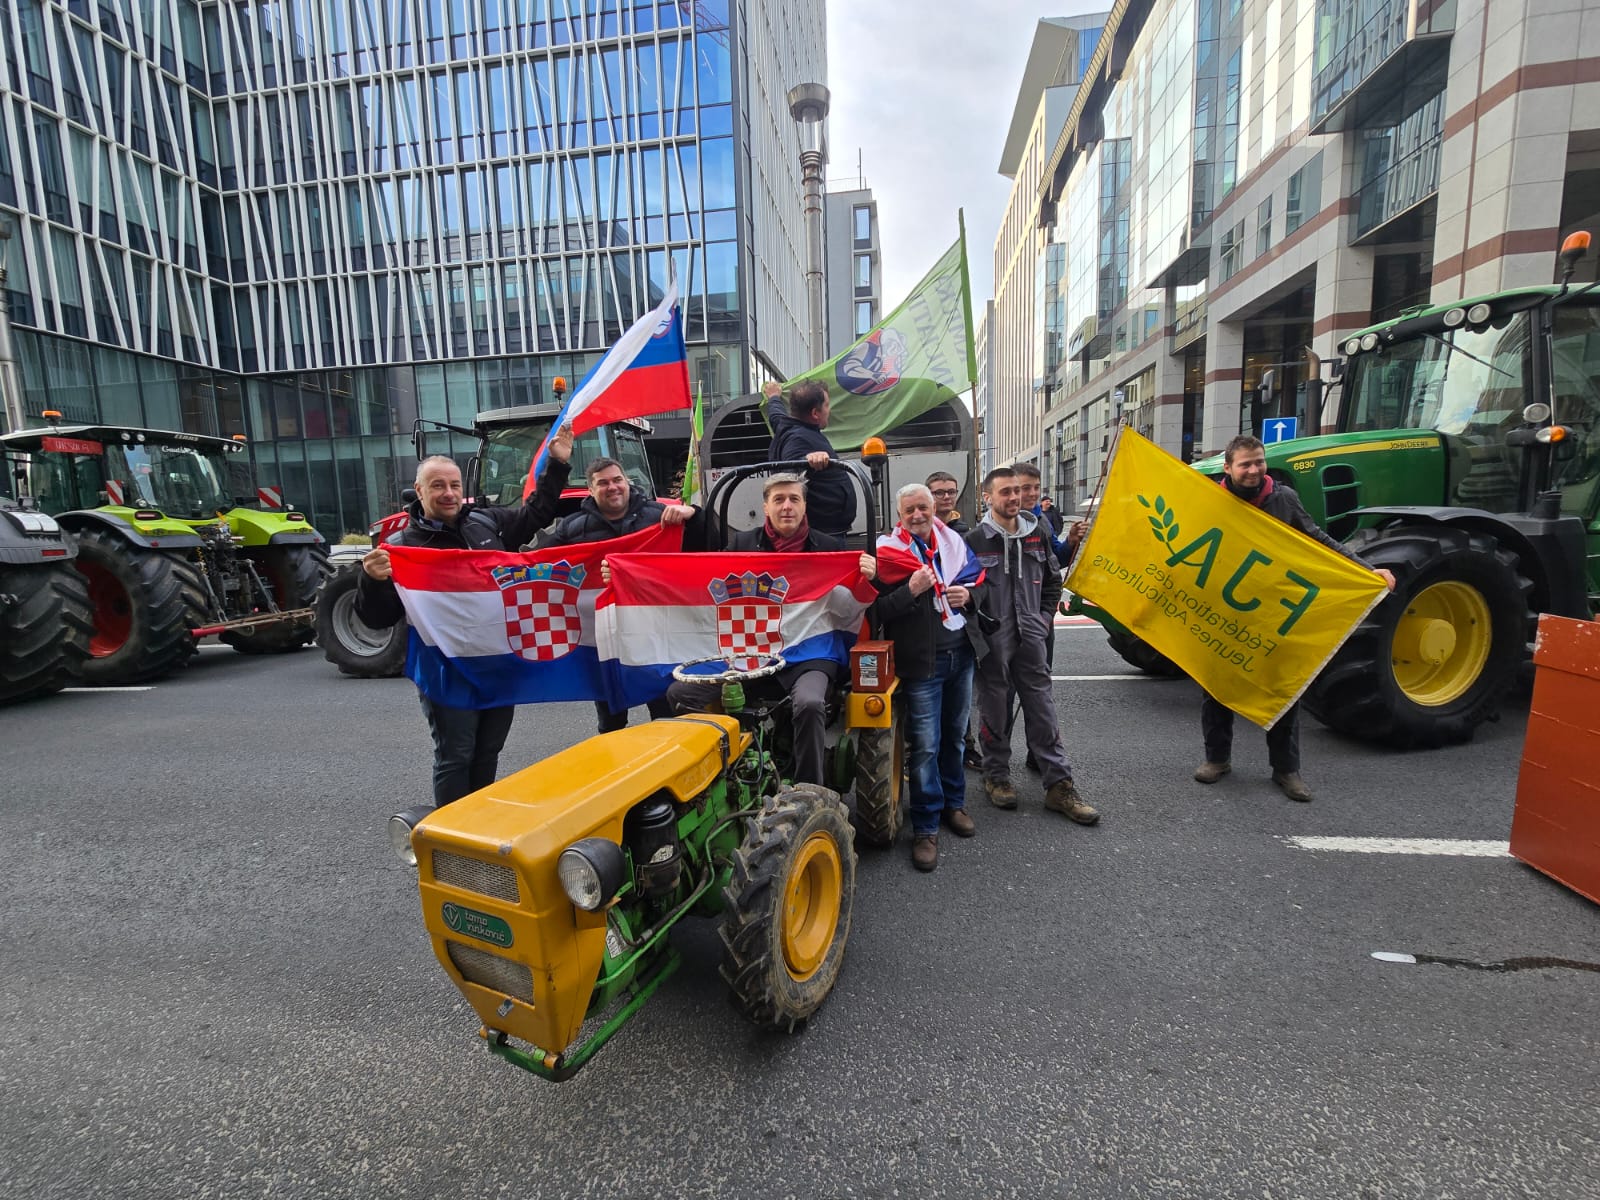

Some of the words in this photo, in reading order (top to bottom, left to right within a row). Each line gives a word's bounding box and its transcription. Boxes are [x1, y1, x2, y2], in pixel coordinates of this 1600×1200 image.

[1391, 441, 1406, 450] JOHN
[1293, 460, 1316, 470] 6830
[465, 911, 488, 926] tomo
